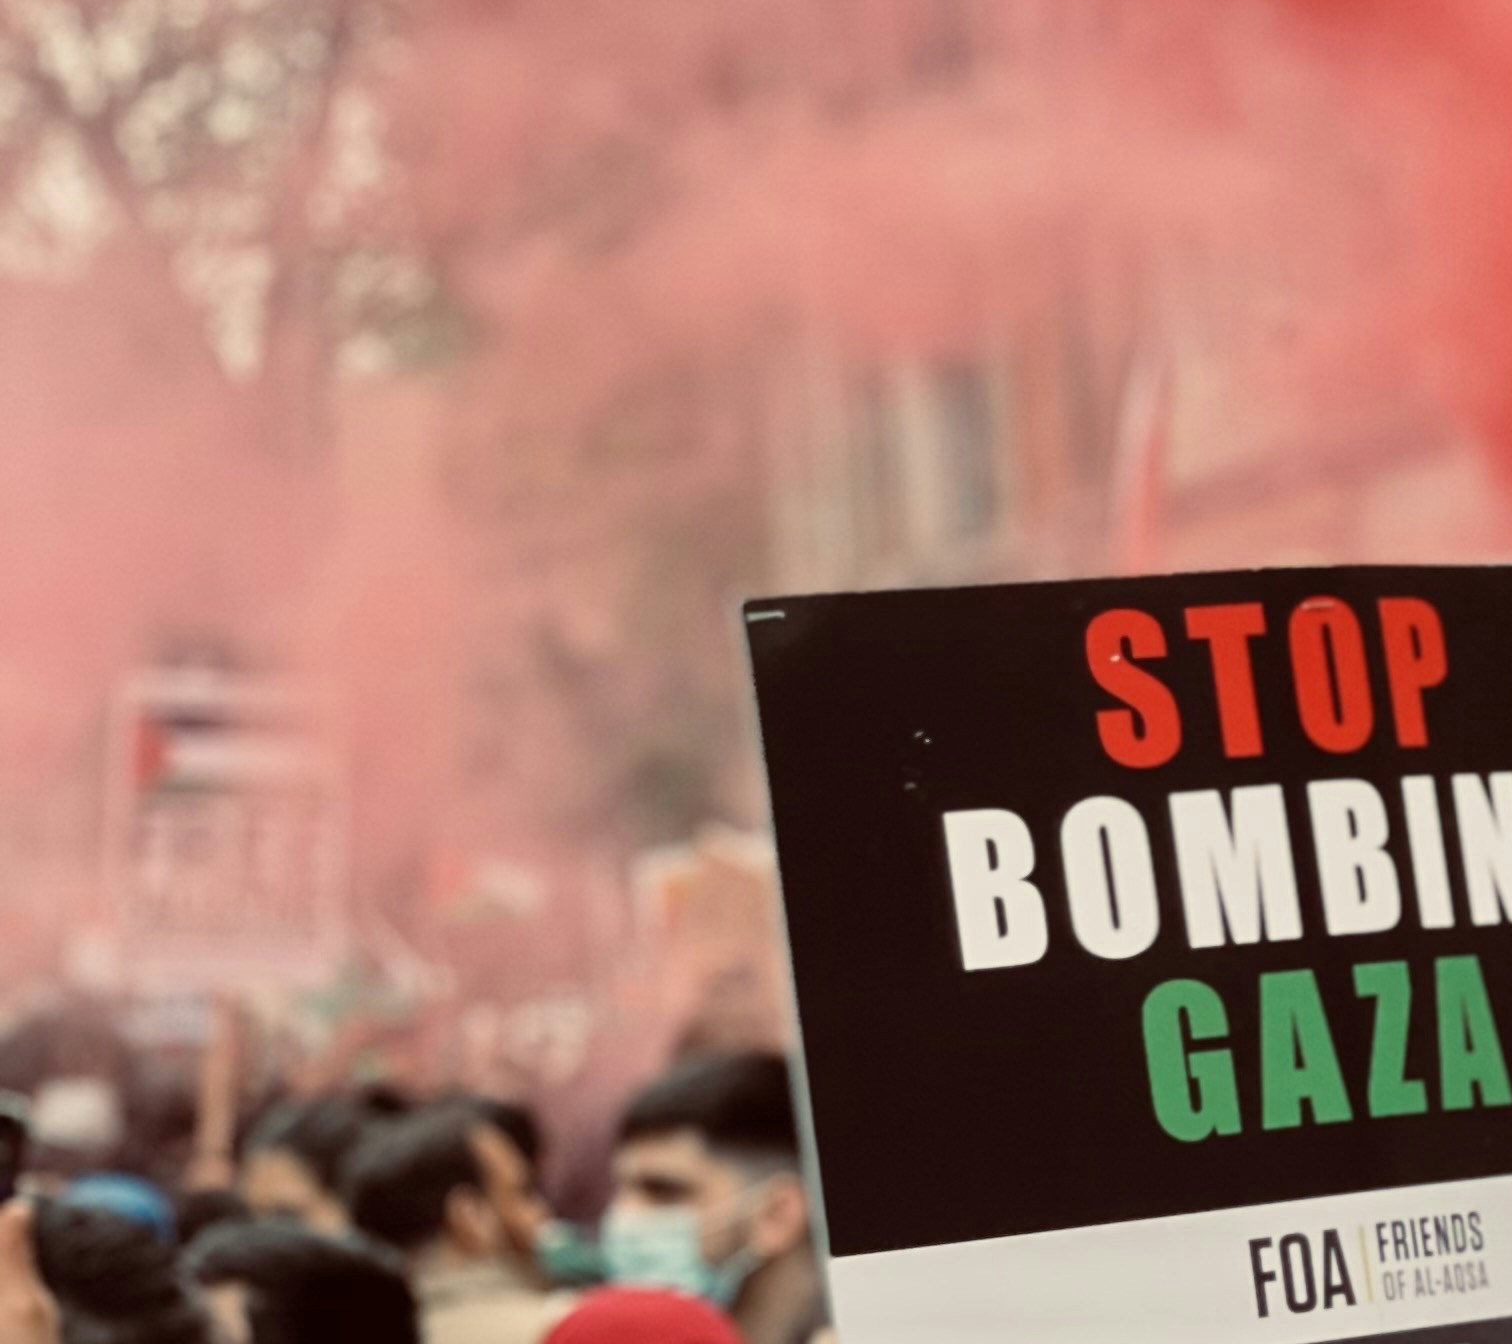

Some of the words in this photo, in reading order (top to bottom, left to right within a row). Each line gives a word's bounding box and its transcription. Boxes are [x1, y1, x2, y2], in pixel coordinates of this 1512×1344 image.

[1084, 595, 1449, 768] STOP
[1140, 954, 1512, 1142] GAZA
[1248, 1228, 1357, 1318] FOA
[1375, 1211, 1484, 1263] FRIENDS
[1383, 1269, 1405, 1301] OF
[1415, 1260, 1489, 1298] AL-AQSA
